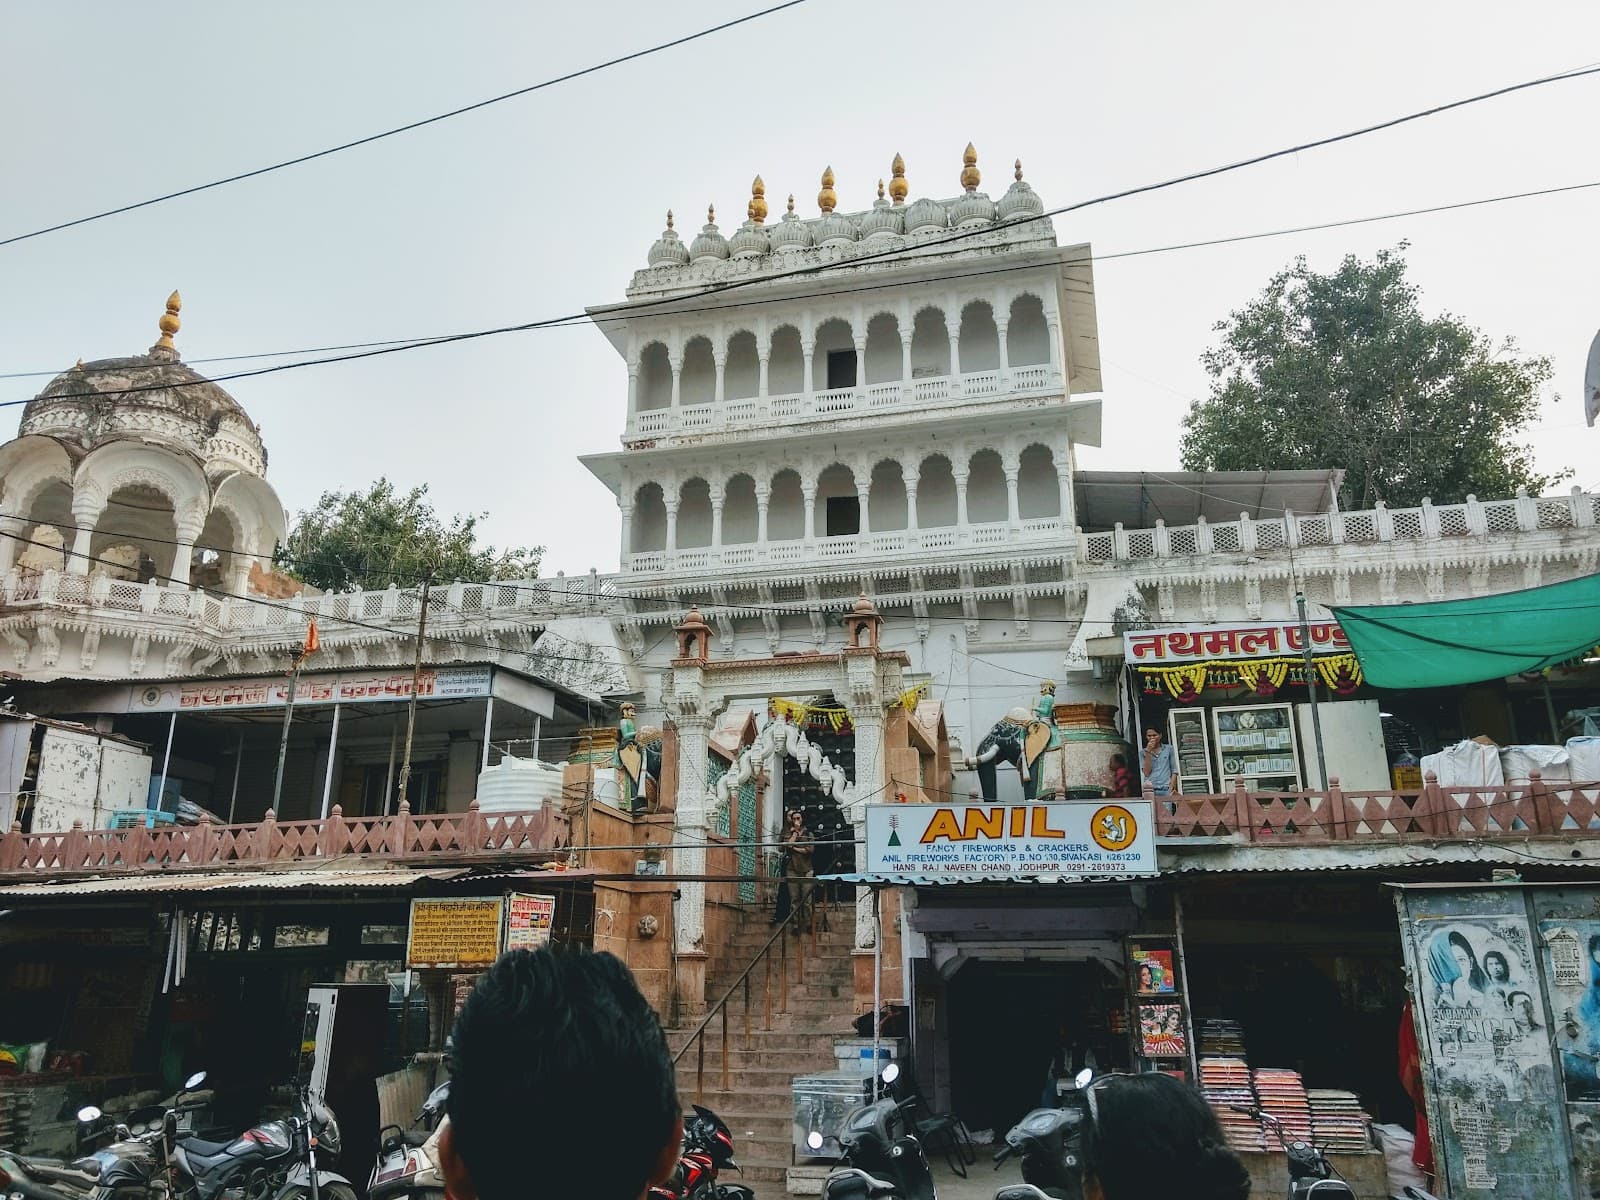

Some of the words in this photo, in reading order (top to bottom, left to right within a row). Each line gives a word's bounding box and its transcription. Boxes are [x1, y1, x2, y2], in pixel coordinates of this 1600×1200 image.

[1129, 627, 1281, 658] नथमल
[919, 807, 1066, 843] ANIL
[926, 845, 956, 853] FANCY
[962, 844, 1017, 852] FIREWORKS
[1025, 844, 1032, 852] &
[1037, 843, 1089, 852] CRACKERS
[882, 855, 902, 863] ANIL
[906, 854, 960, 862] FIREWORKS
[964, 854, 1006, 862] FACTORY
[893, 863, 916, 872] HANS
[922, 863, 940, 872] RAJ
[944, 863, 977, 871] NAVEEN
[1018, 863, 1060, 871] JODHPUR
